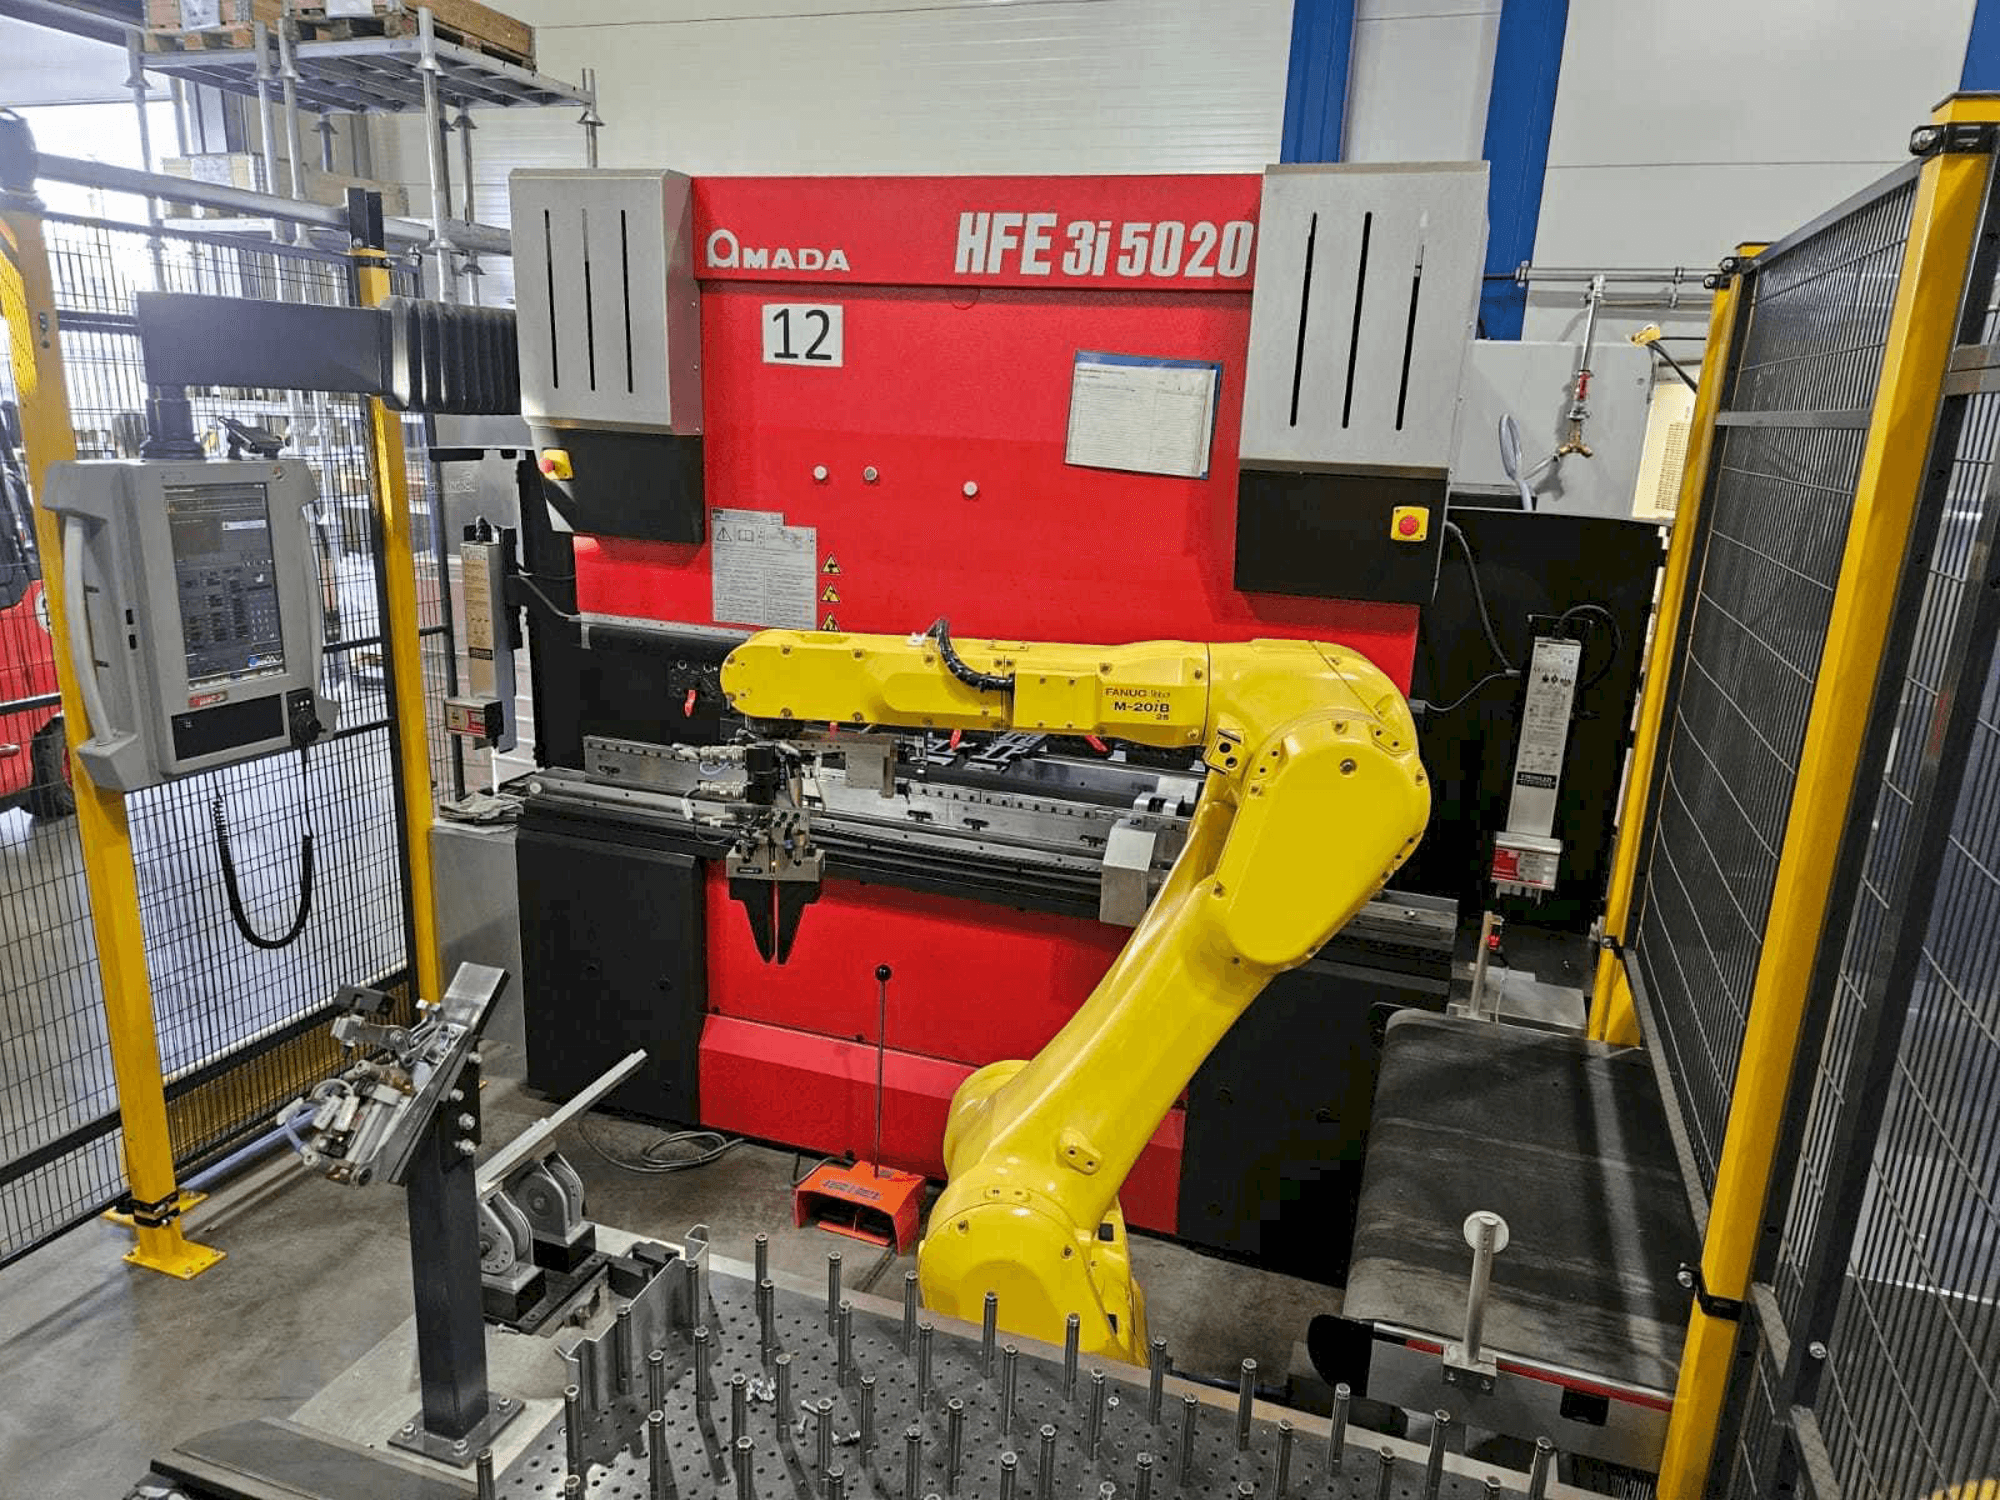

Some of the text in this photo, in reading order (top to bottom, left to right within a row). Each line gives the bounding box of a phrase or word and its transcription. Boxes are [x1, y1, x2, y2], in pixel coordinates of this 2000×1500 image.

[706, 228, 851, 271] AMADA
[953, 211, 1255, 279] HFE 3i 5020
[772, 308, 832, 362] 12
[1105, 688, 1147, 698] FANUC
